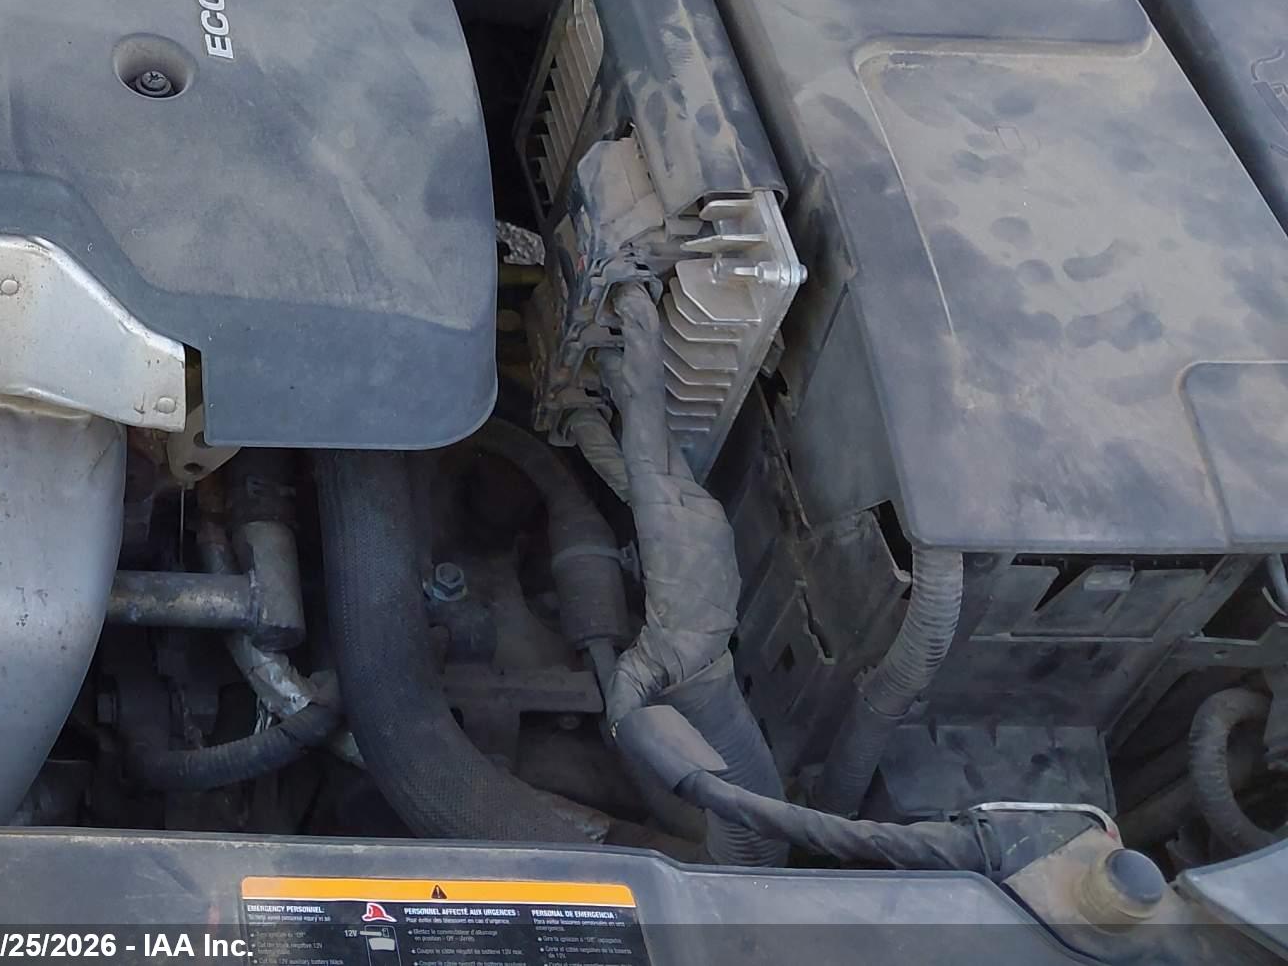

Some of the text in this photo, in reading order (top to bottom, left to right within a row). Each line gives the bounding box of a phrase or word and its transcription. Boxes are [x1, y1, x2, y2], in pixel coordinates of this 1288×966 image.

[247, 904, 285, 913] EMERGENCY
[403, 907, 441, 915] PERSONNEL
[469, 908, 482, 916] AUX
[483, 909, 516, 917] URGENCES
[531, 909, 564, 917] PERSONAL
[565, 910, 574, 918] DE
[344, 929, 358, 938] 12V
